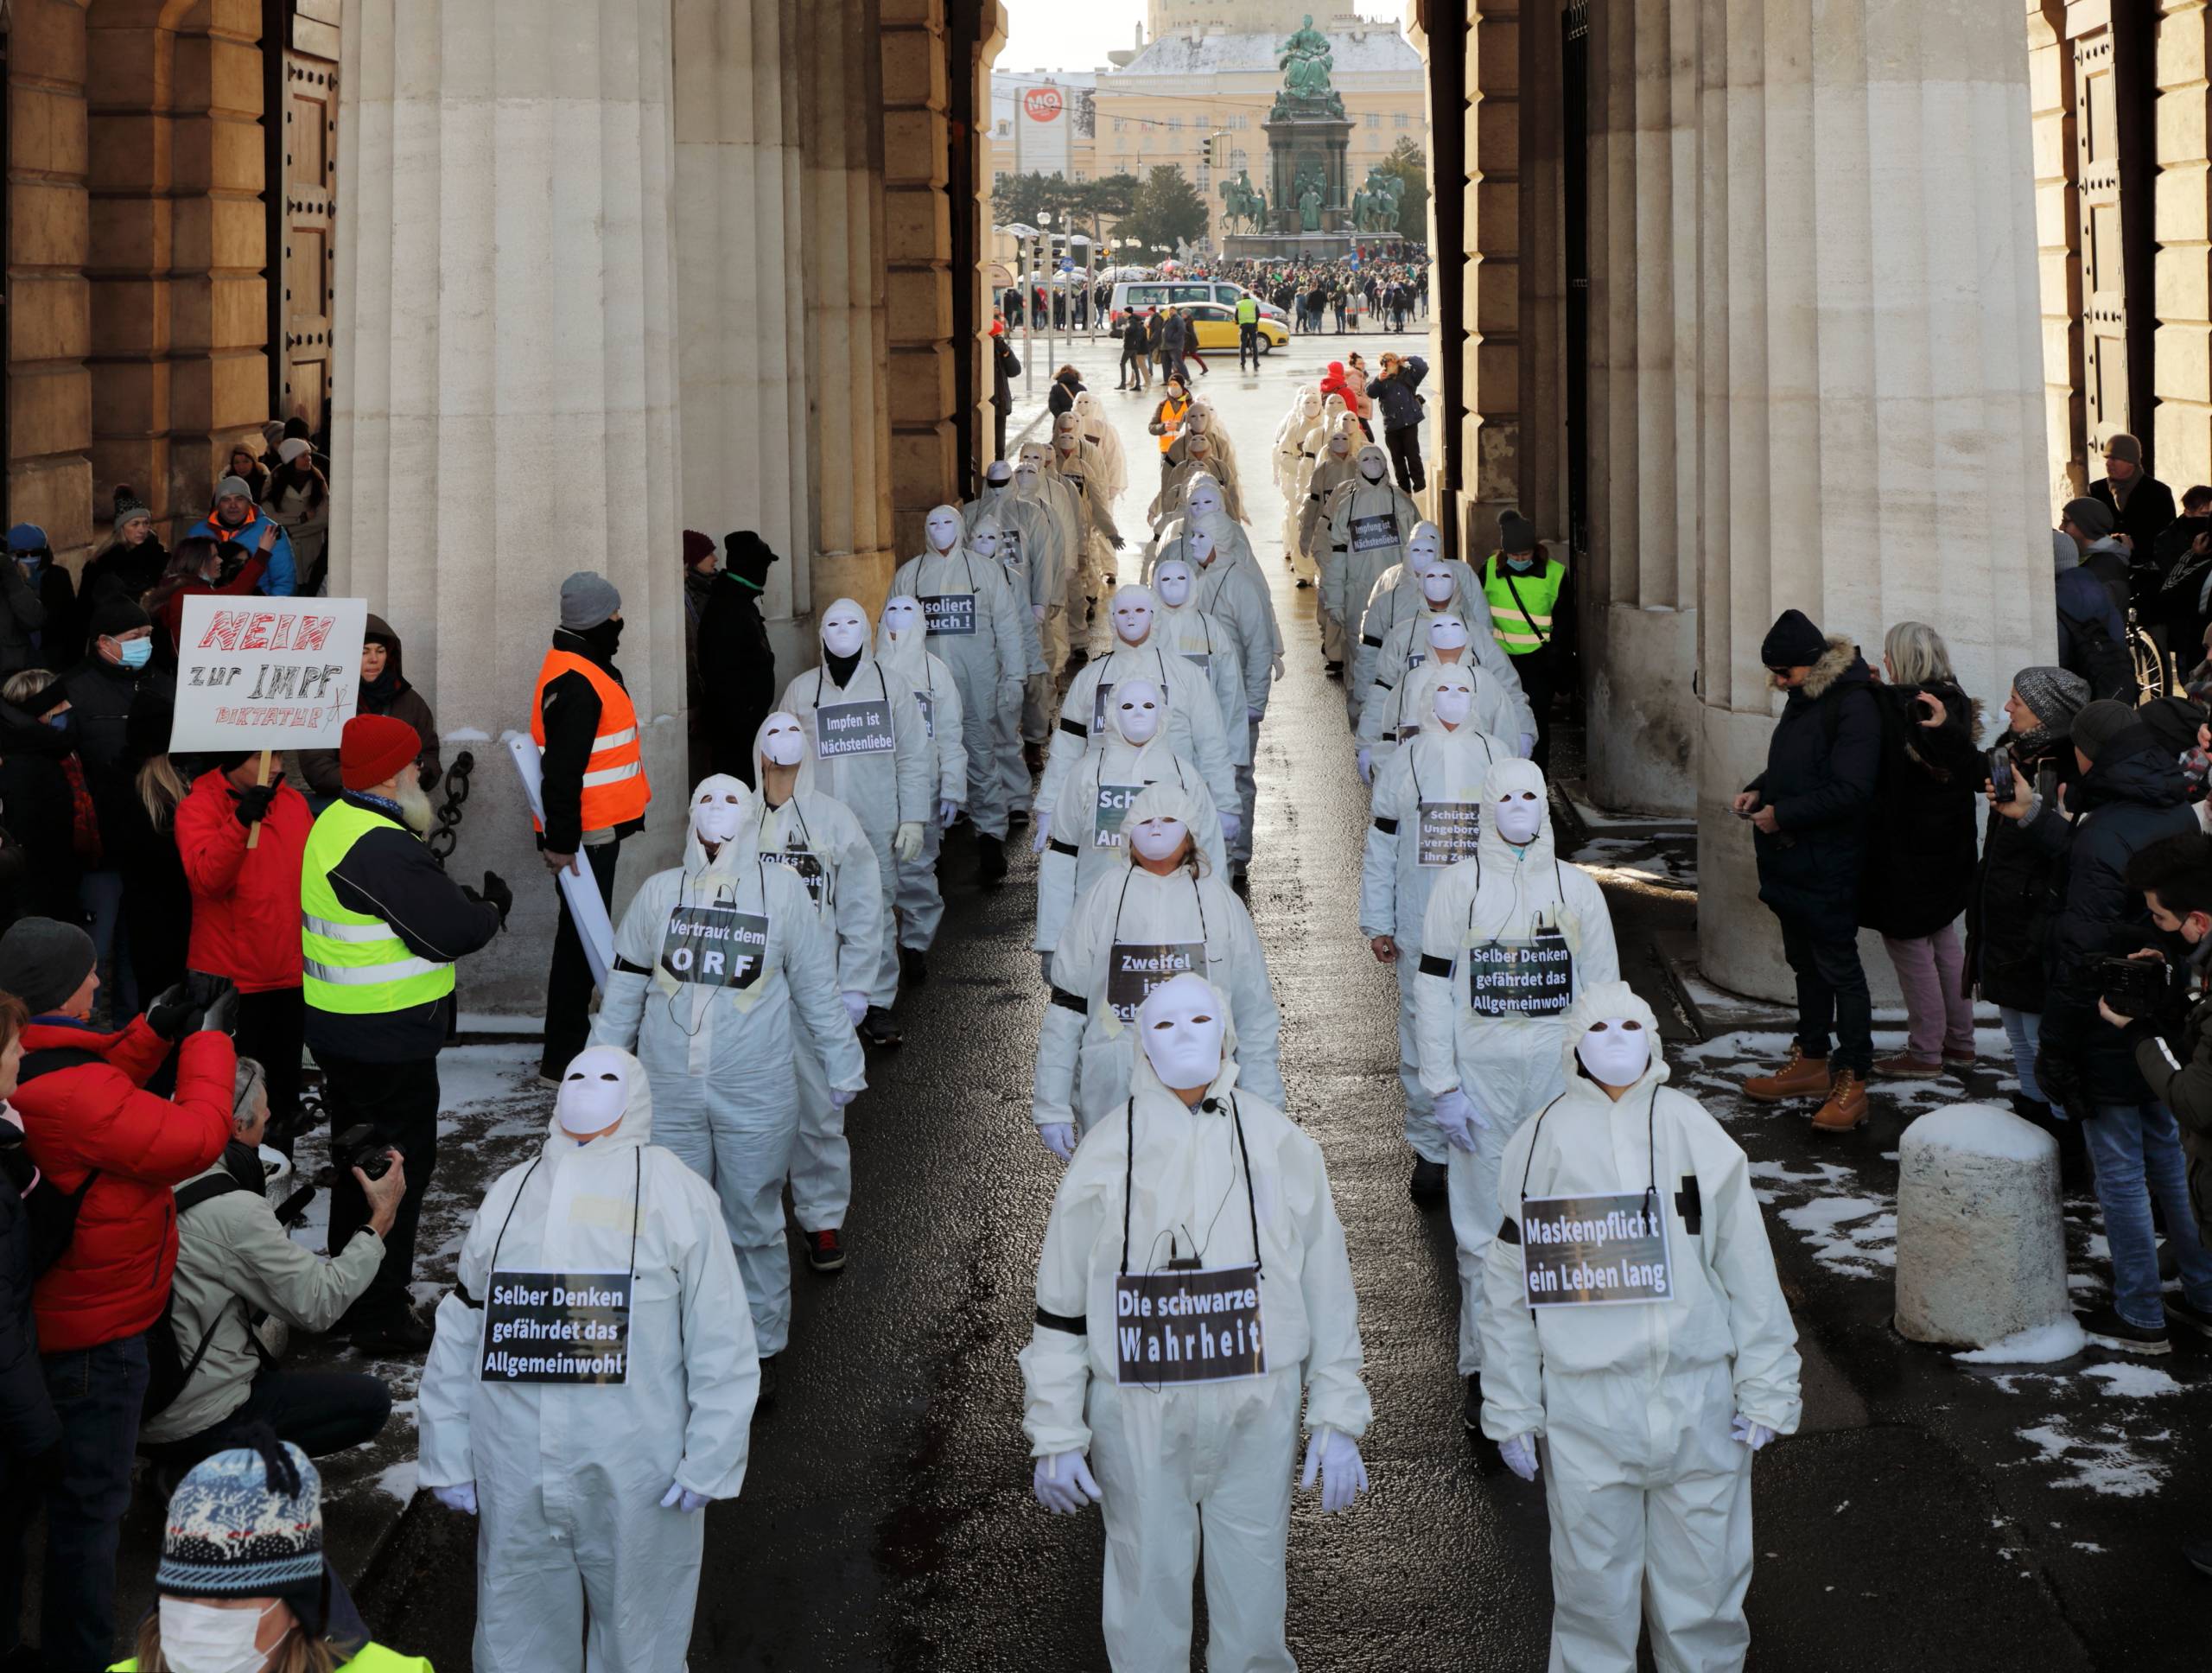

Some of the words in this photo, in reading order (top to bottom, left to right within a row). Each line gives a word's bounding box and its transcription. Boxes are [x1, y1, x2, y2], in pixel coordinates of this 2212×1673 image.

[1027, 93, 1059, 111] MQ
[198, 611, 335, 651] NEIN
[247, 665, 343, 699] IMPF
[215, 707, 323, 728] DIKTATUR
[826, 714, 863, 732] Impfen
[867, 712, 880, 726] ist
[821, 735, 893, 754] Nächstenliebe
[1431, 810, 1476, 820] Schützt
[1424, 824, 1479, 836] Ungebore
[1420, 838, 1478, 848] -verzichte
[1424, 852, 1448, 862] ihre
[671, 919, 730, 940] Vertraut
[734, 926, 766, 945] dem
[1122, 953, 1192, 969] Zweifel
[1474, 949, 1518, 963] Selber
[1521, 948, 1568, 963] Denken
[1143, 978, 1166, 995] is
[1477, 971, 1543, 989] gefährdet
[1546, 970, 1567, 985] das
[1473, 993, 1570, 1014] Allgemeinwohl
[1526, 1210, 1660, 1247] Maskenpflicht
[1529, 1262, 1558, 1292] ein
[1560, 1261, 1619, 1291] Leben
[1622, 1258, 1667, 1293] lang
[493, 1284, 549, 1306] Selber
[552, 1286, 623, 1307] Denken
[1118, 1288, 1152, 1317] Die
[1158, 1288, 1256, 1317] schwarze
[493, 1318, 580, 1343] gefährdet
[584, 1320, 618, 1339] das
[1119, 1318, 1261, 1362] Wahrheit
[485, 1351, 623, 1377] Allgemeinwohl
